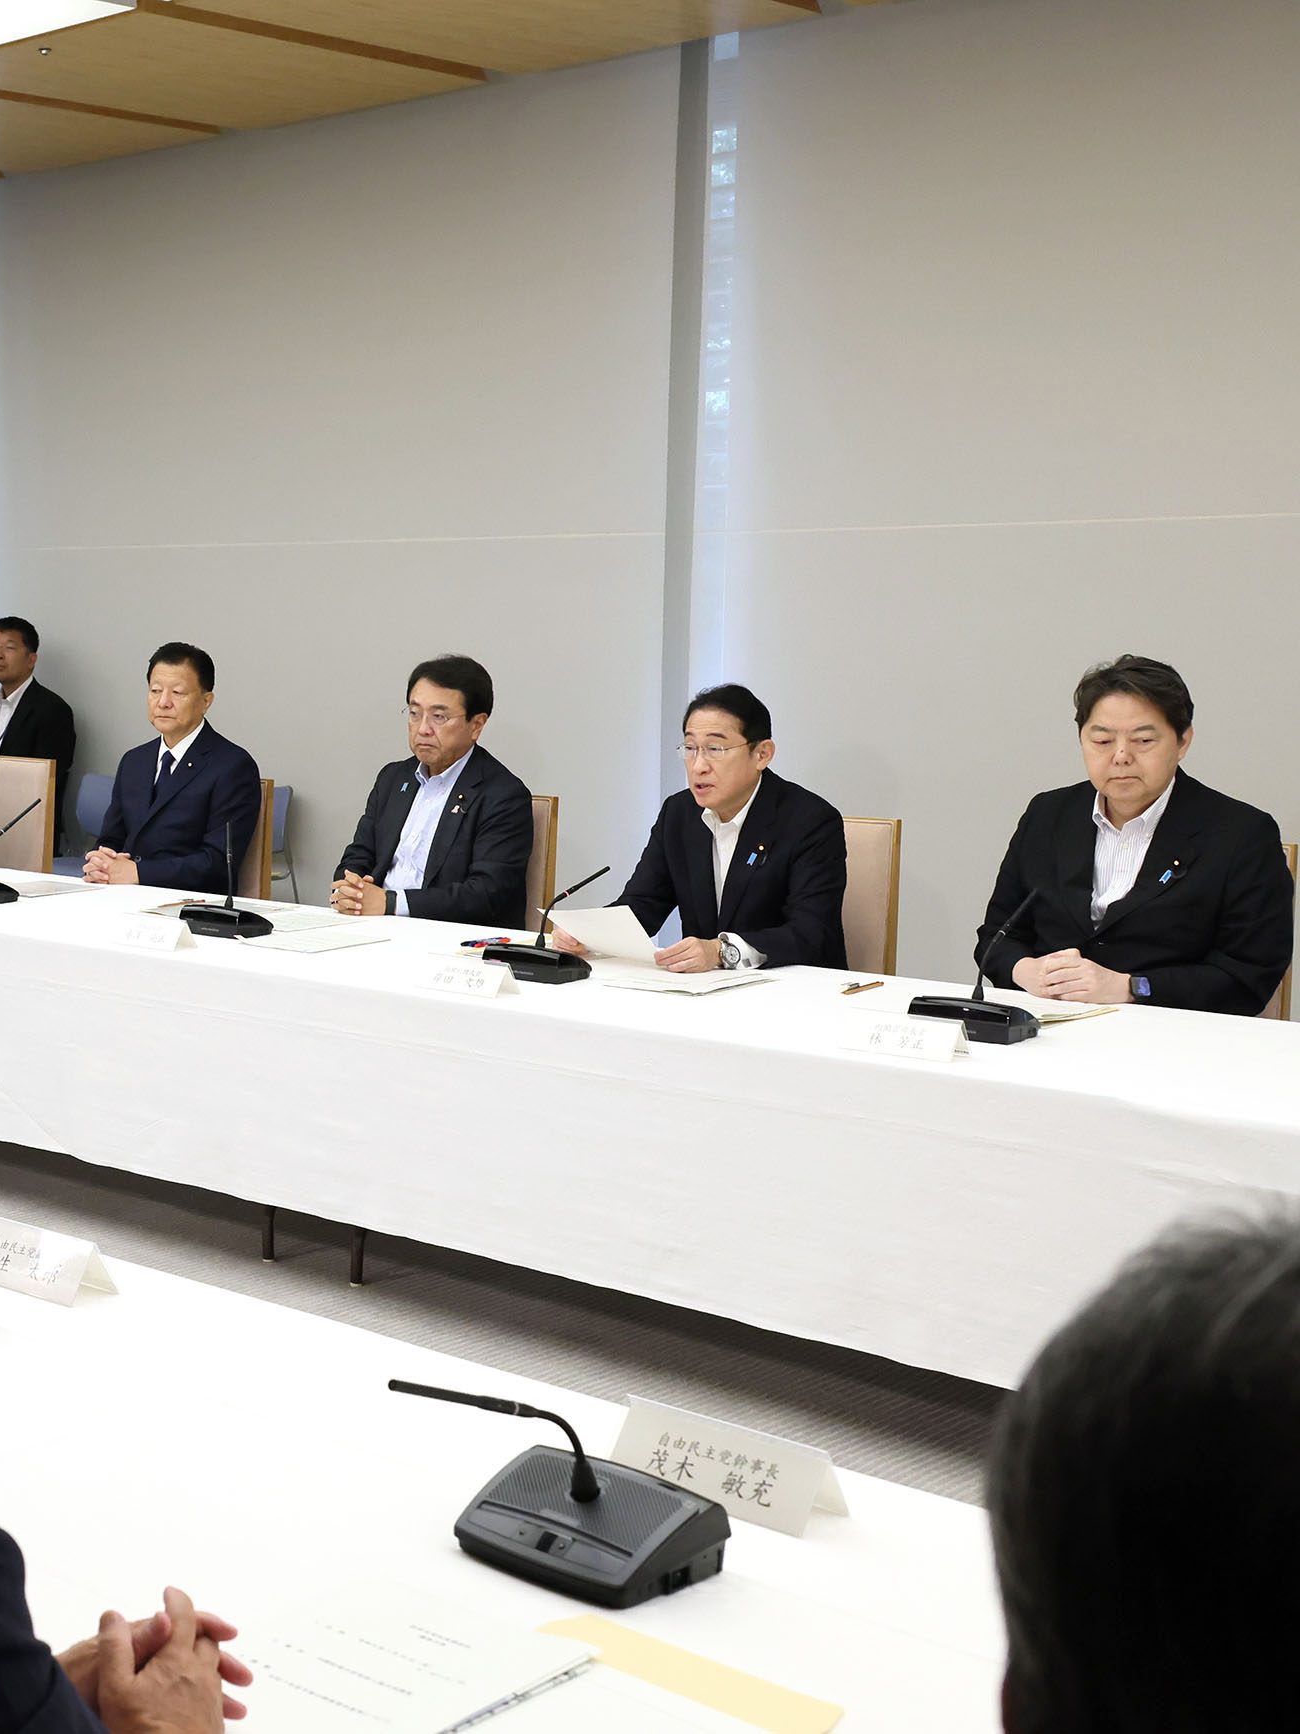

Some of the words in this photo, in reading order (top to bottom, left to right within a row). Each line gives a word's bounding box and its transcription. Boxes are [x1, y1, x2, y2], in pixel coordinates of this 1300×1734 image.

[645, 1447, 695, 1482] 茂木
[720, 1471, 775, 1508] 敏充
[657, 1431, 781, 1481] 自由民主党幹事長
